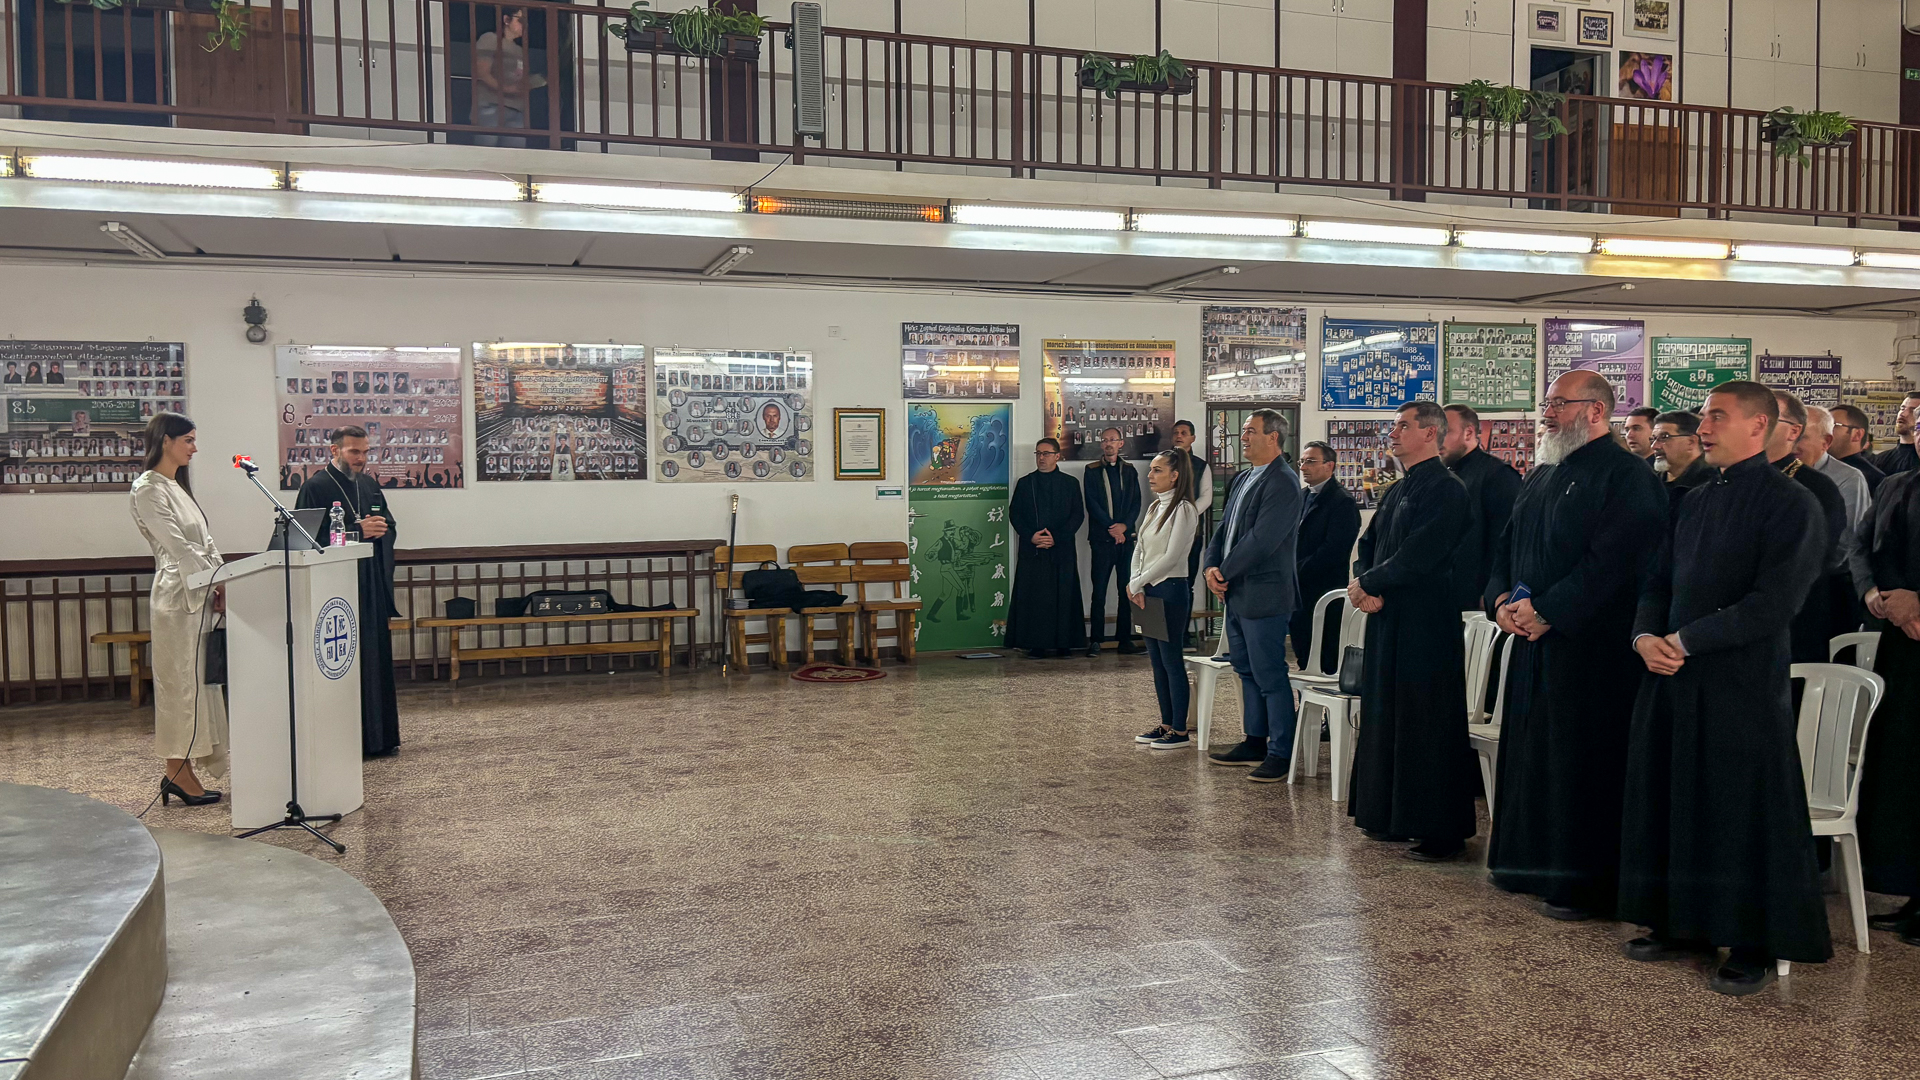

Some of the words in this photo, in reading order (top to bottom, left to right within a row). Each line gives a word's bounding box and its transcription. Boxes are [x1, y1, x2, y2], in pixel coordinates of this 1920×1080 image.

[31, 342, 84, 352] Zsigmond
[1627, 362, 1642, 371] 1987
[1626, 373, 1642, 382] 1995
[12, 400, 36, 414] 8.b
